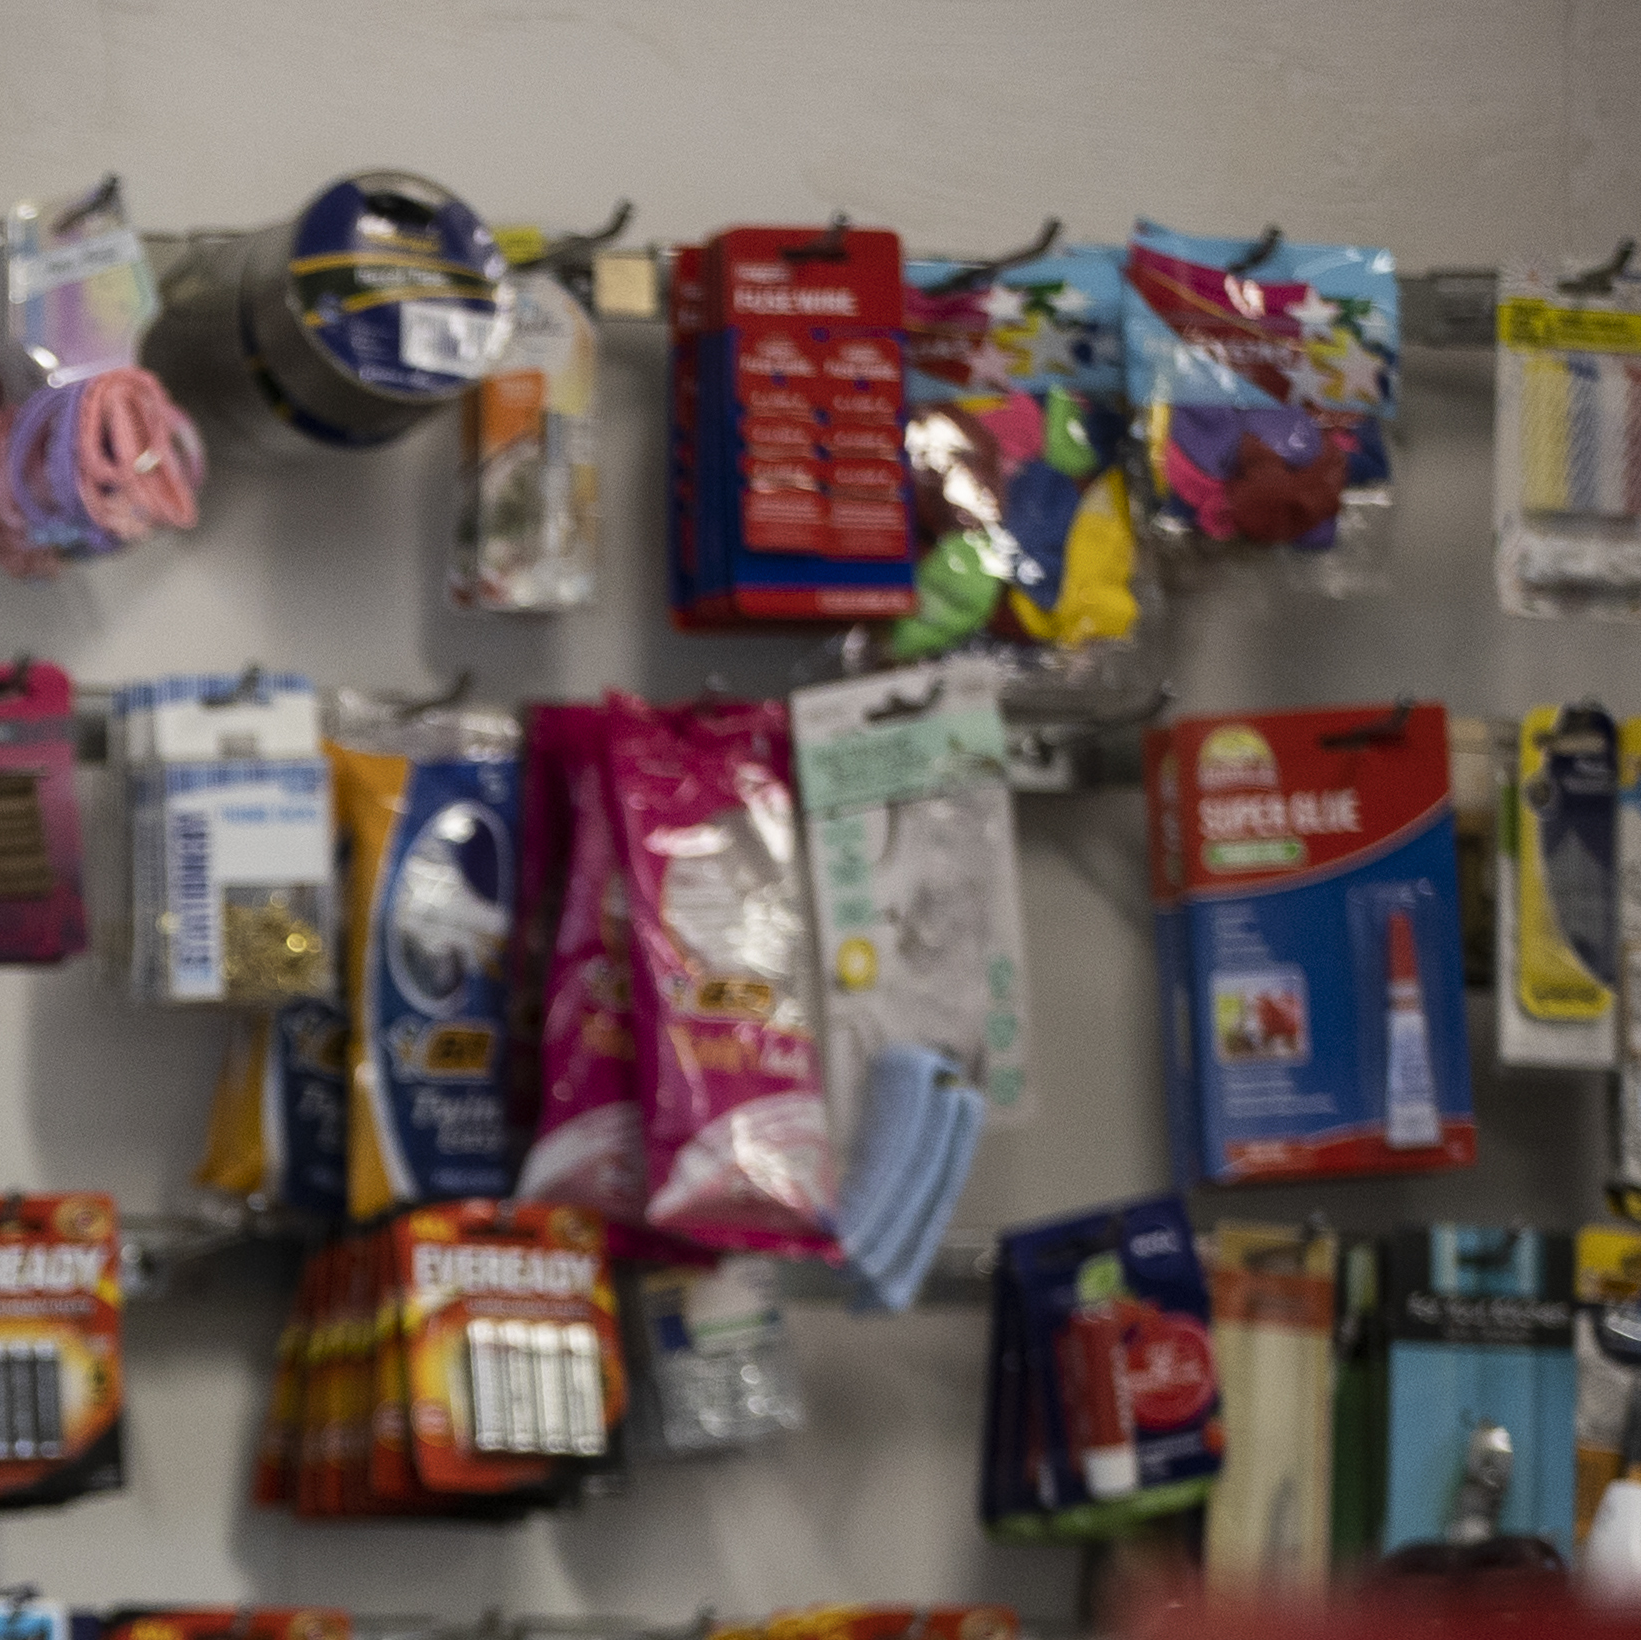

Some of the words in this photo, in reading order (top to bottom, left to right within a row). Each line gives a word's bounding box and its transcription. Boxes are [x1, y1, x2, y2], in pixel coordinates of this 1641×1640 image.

[1199, 794, 1288, 839] SUPER
[1290, 787, 1362, 834] GLUE
[412, 1244, 601, 1296] EVEREADY
